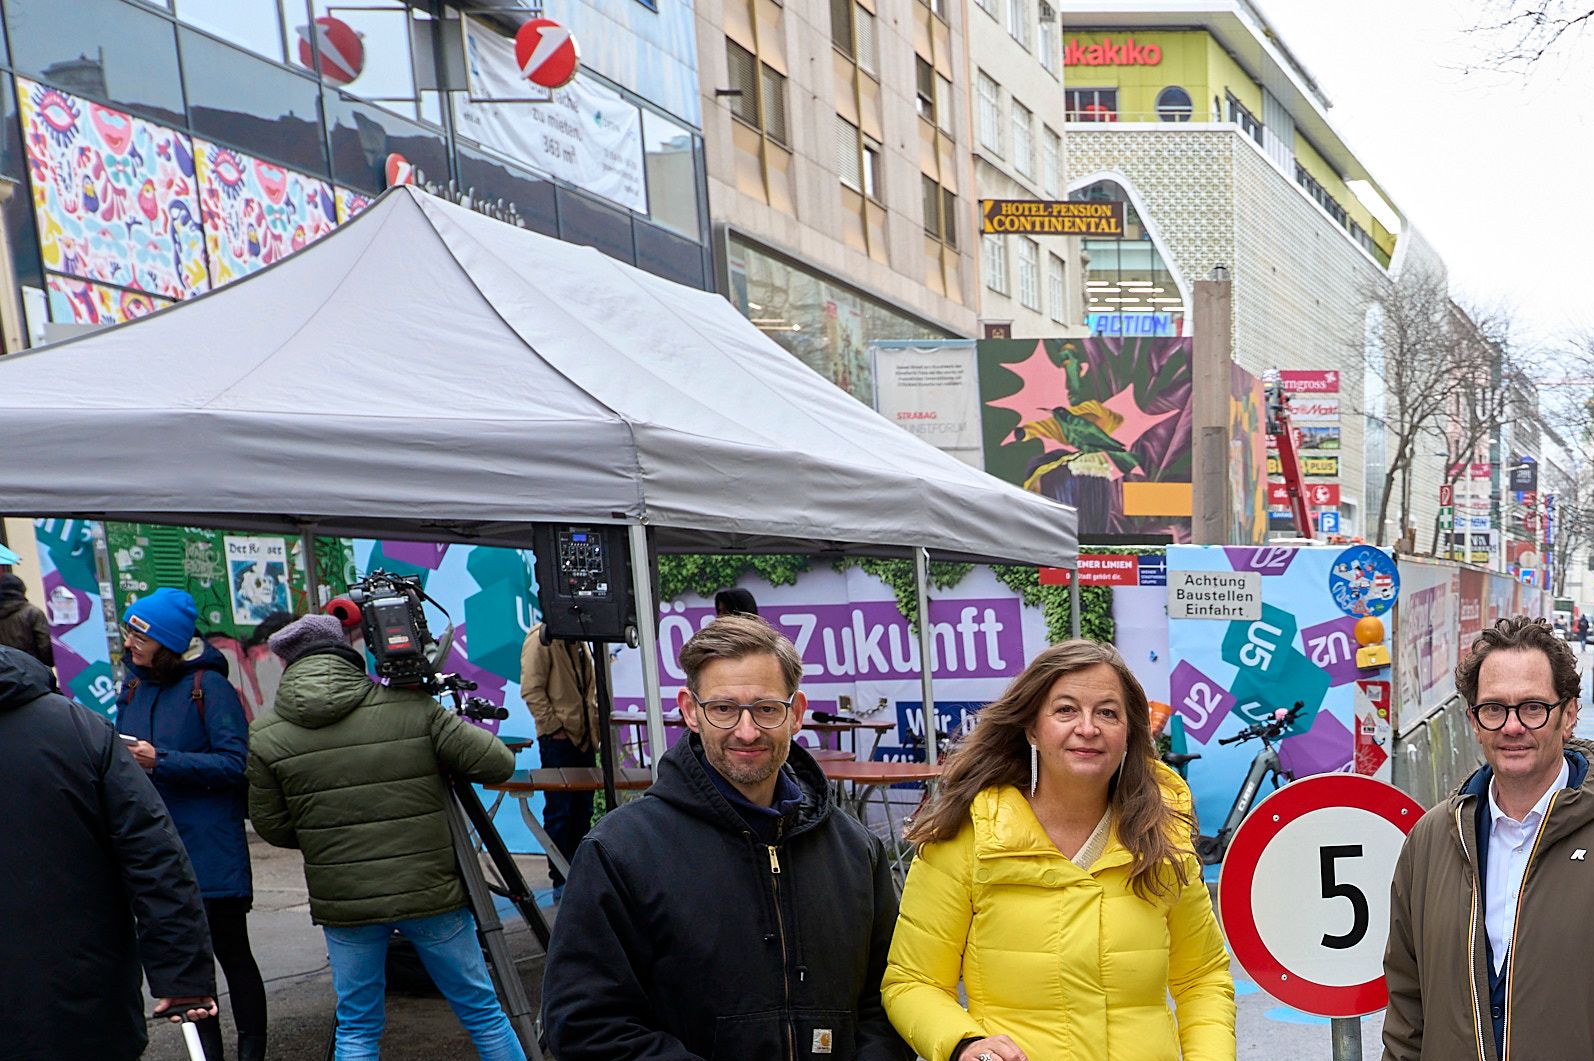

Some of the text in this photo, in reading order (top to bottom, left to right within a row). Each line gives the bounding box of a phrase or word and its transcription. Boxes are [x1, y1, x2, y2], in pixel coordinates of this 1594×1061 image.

[543, 136, 561, 158] 363
[1001, 202, 1112, 217] HOTEL-PENSION
[993, 215, 1121, 233] CONTINENTAL
[896, 412, 937, 420] STRABAG
[1077, 560, 1132, 569] ENER LINIEN
[1250, 548, 1292, 568] U2
[1185, 574, 1245, 589] Achtung
[1177, 589, 1253, 602] Baustellen
[1186, 604, 1243, 616] Einfahrt
[1239, 621, 1282, 671] U5
[1308, 632, 1351, 668] U2
[1177, 682, 1223, 731] U2
[906, 708, 952, 736] Wir
[1319, 844, 1369, 949] 5
